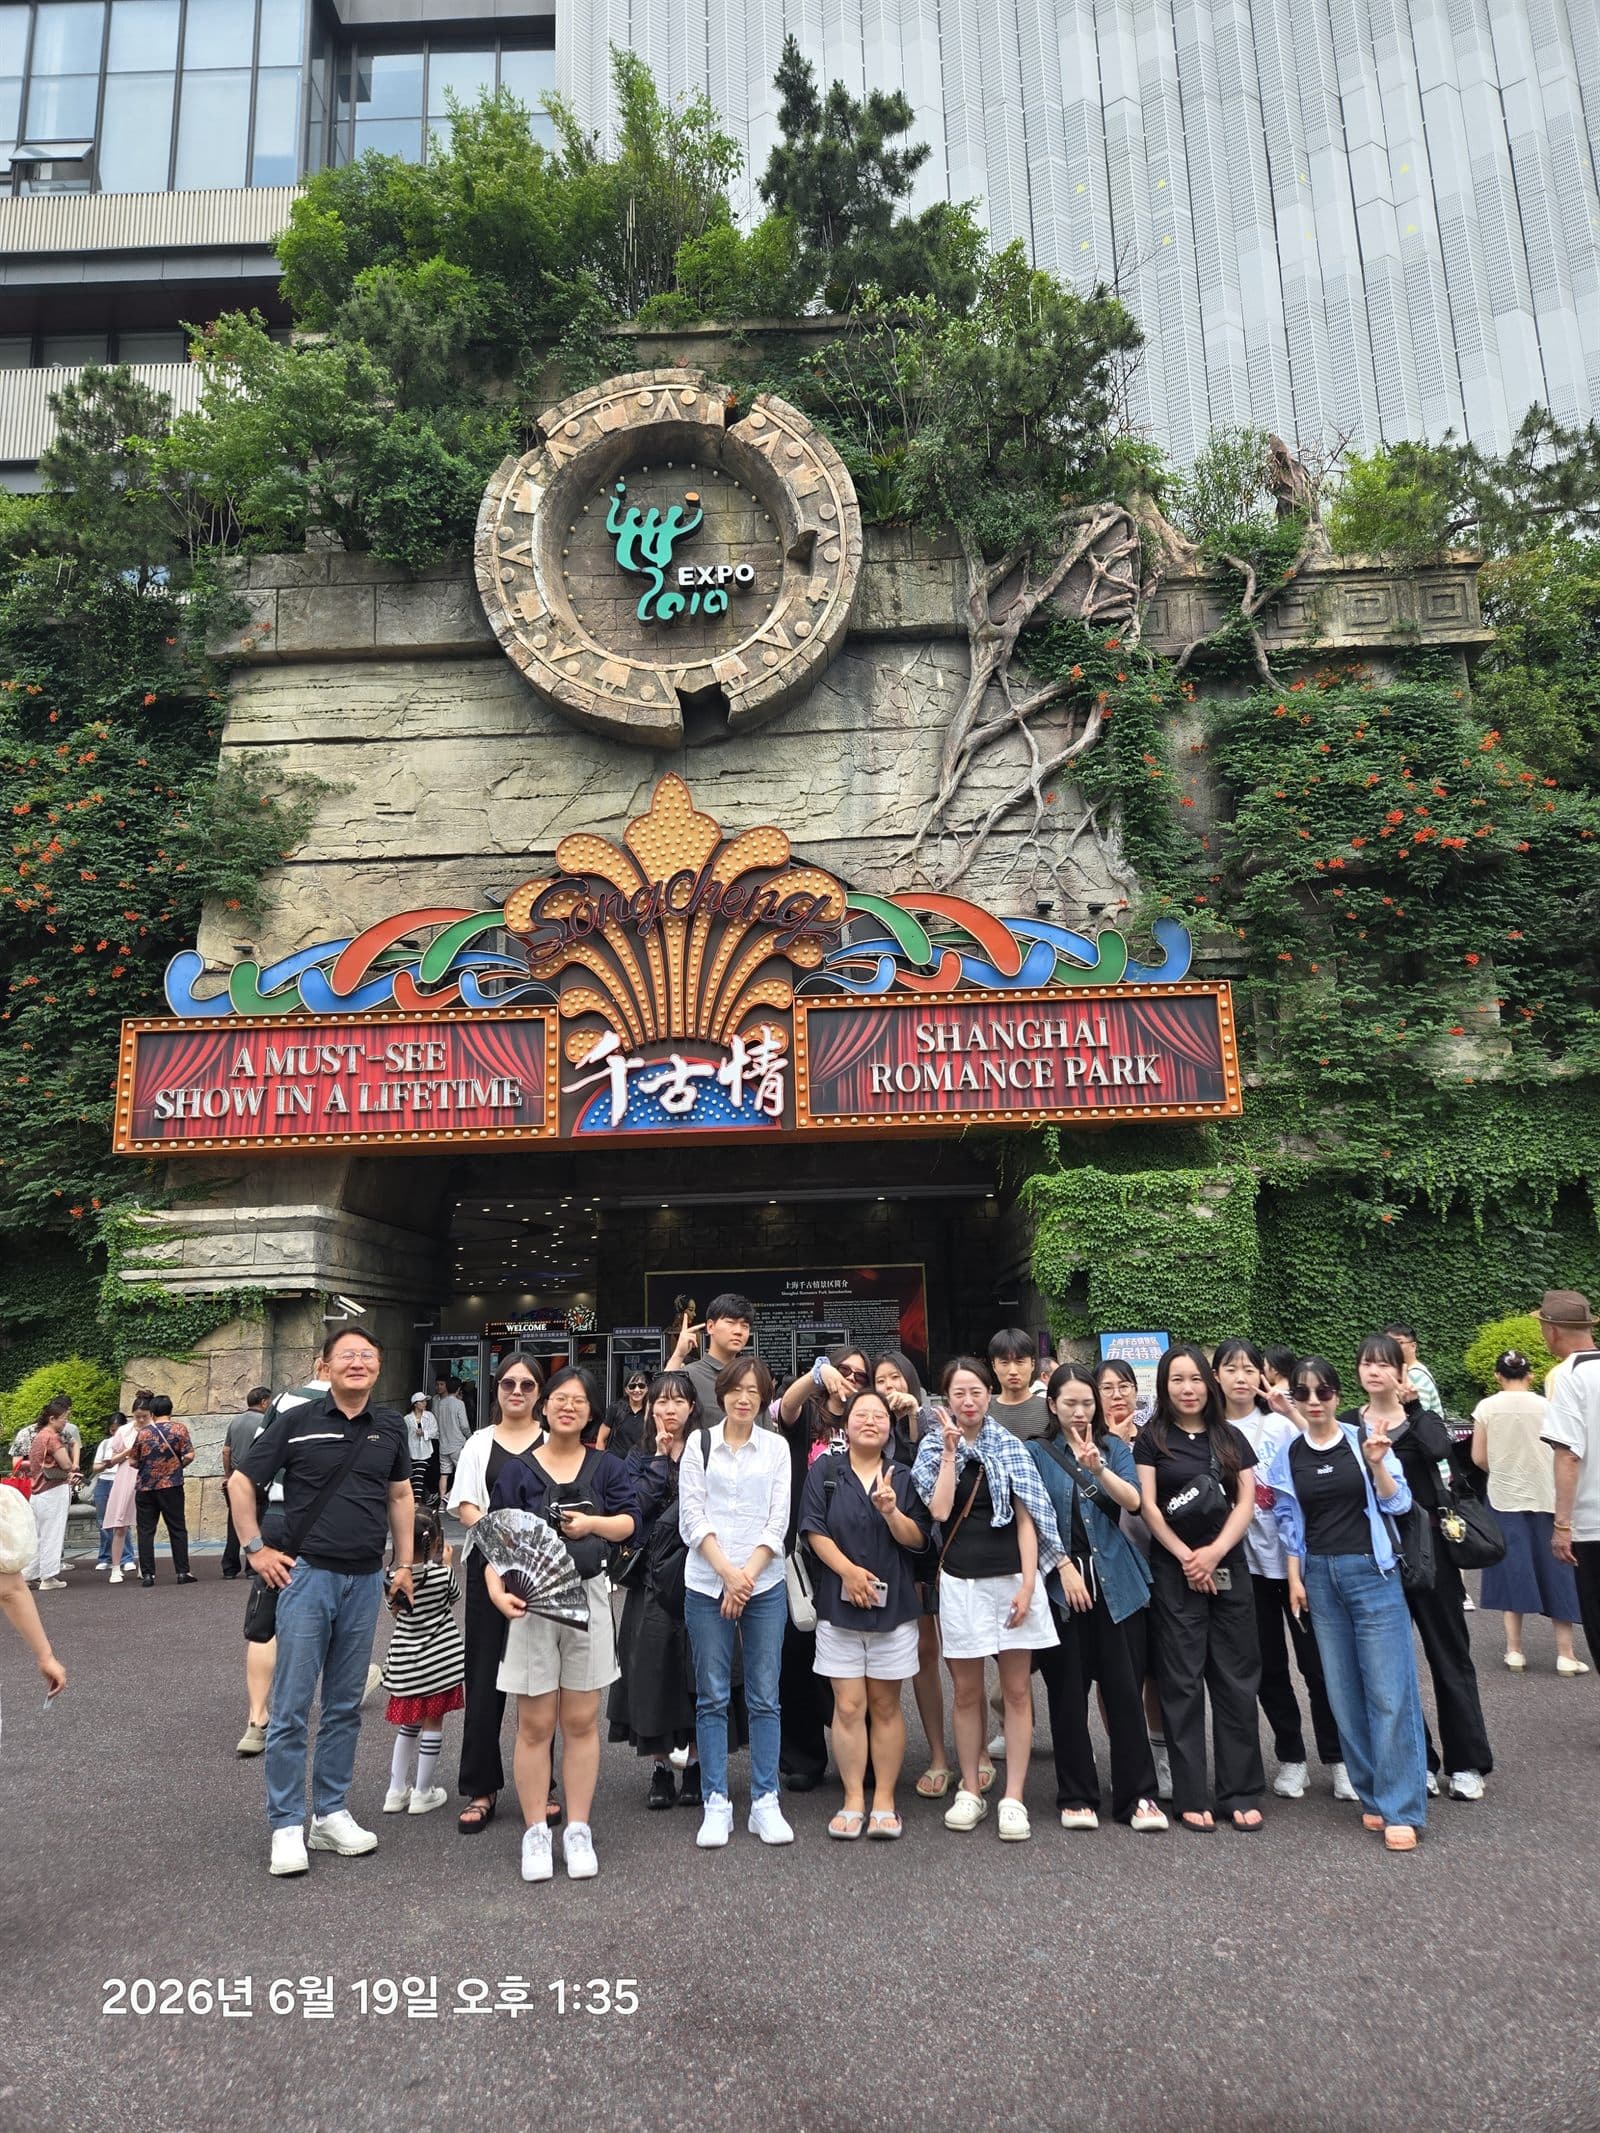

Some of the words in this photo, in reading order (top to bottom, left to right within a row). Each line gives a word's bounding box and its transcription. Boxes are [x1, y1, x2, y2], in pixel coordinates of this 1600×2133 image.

[678, 564, 755, 587] EXPO
[916, 1017, 1110, 1054] SHANGHAI
[229, 1048, 255, 1078] A
[265, 1041, 447, 1077] MUST-SEE
[561, 1024, 789, 1127] 千古情
[871, 1058, 1056, 1095] ROMANCE
[1065, 1054, 1163, 1088] PARK
[154, 1086, 266, 1120] SHOW
[274, 1084, 317, 1116] IN
[323, 1084, 350, 1114] A
[358, 1077, 523, 1112] LIFETIME
[506, 1323, 548, 1332] WELCOME
[1167, 1487, 1200, 1515] adidas
